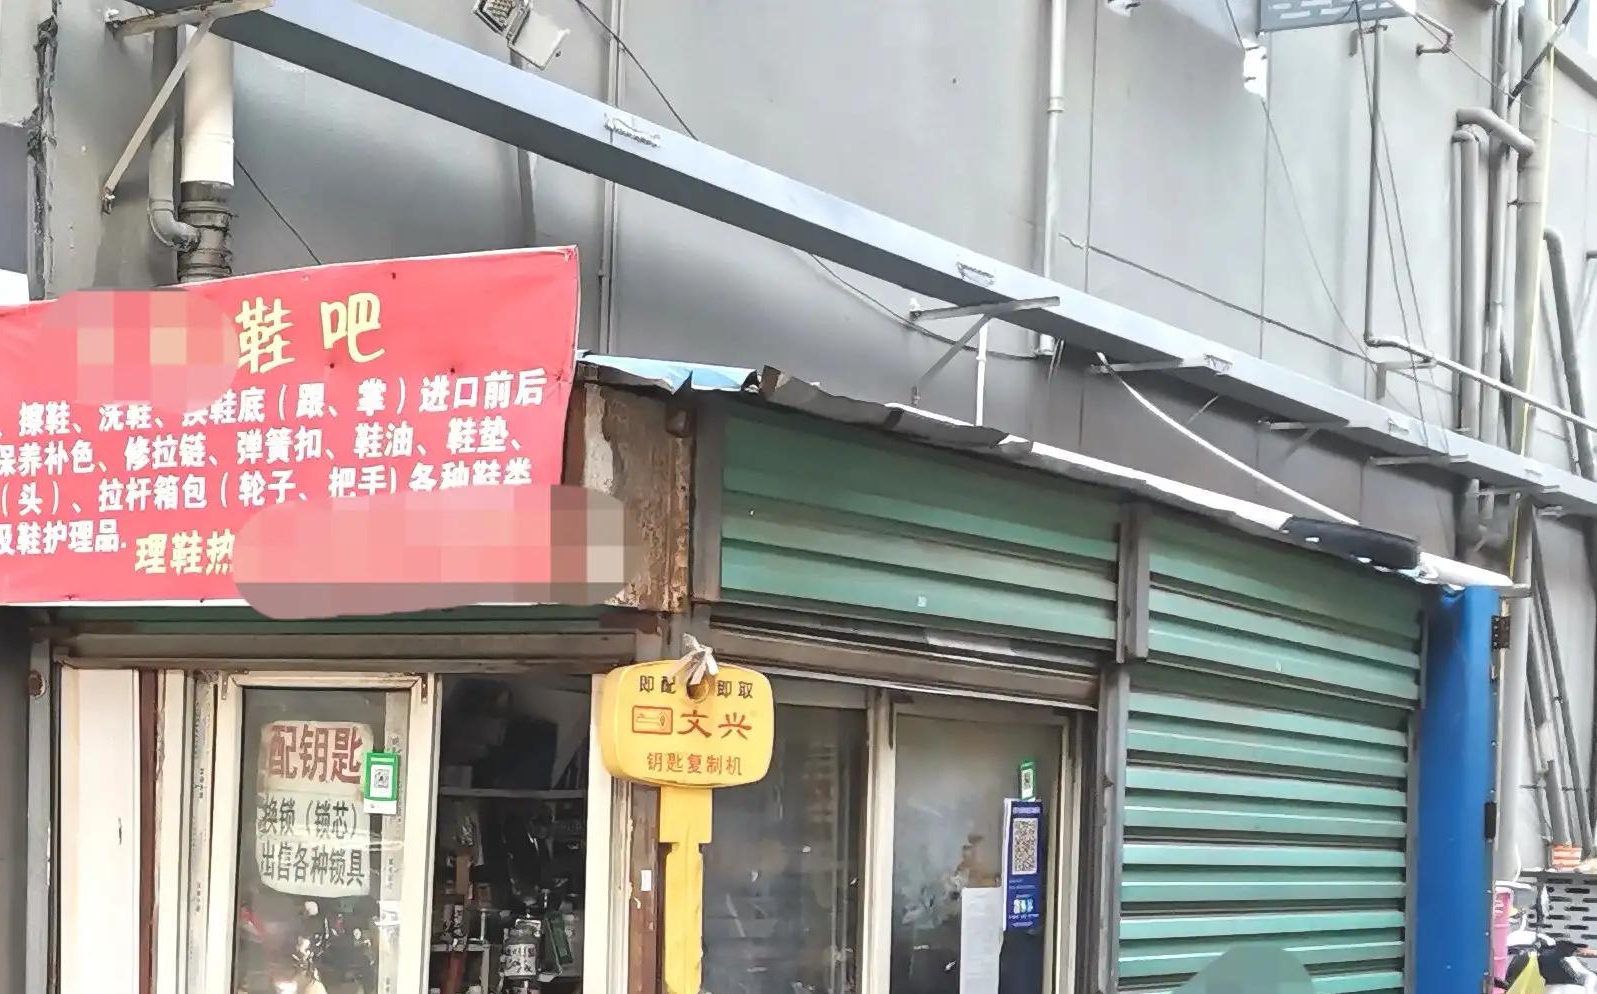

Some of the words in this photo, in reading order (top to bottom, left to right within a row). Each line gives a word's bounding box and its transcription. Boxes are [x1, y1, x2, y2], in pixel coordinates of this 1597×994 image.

[716, 680, 754, 699] 即取
[677, 709, 753, 740] 文兴
[268, 724, 363, 784] 配钥匙
[646, 752, 743, 776] 钥匙复制机
[260, 840, 365, 887] 出售各种锁具
